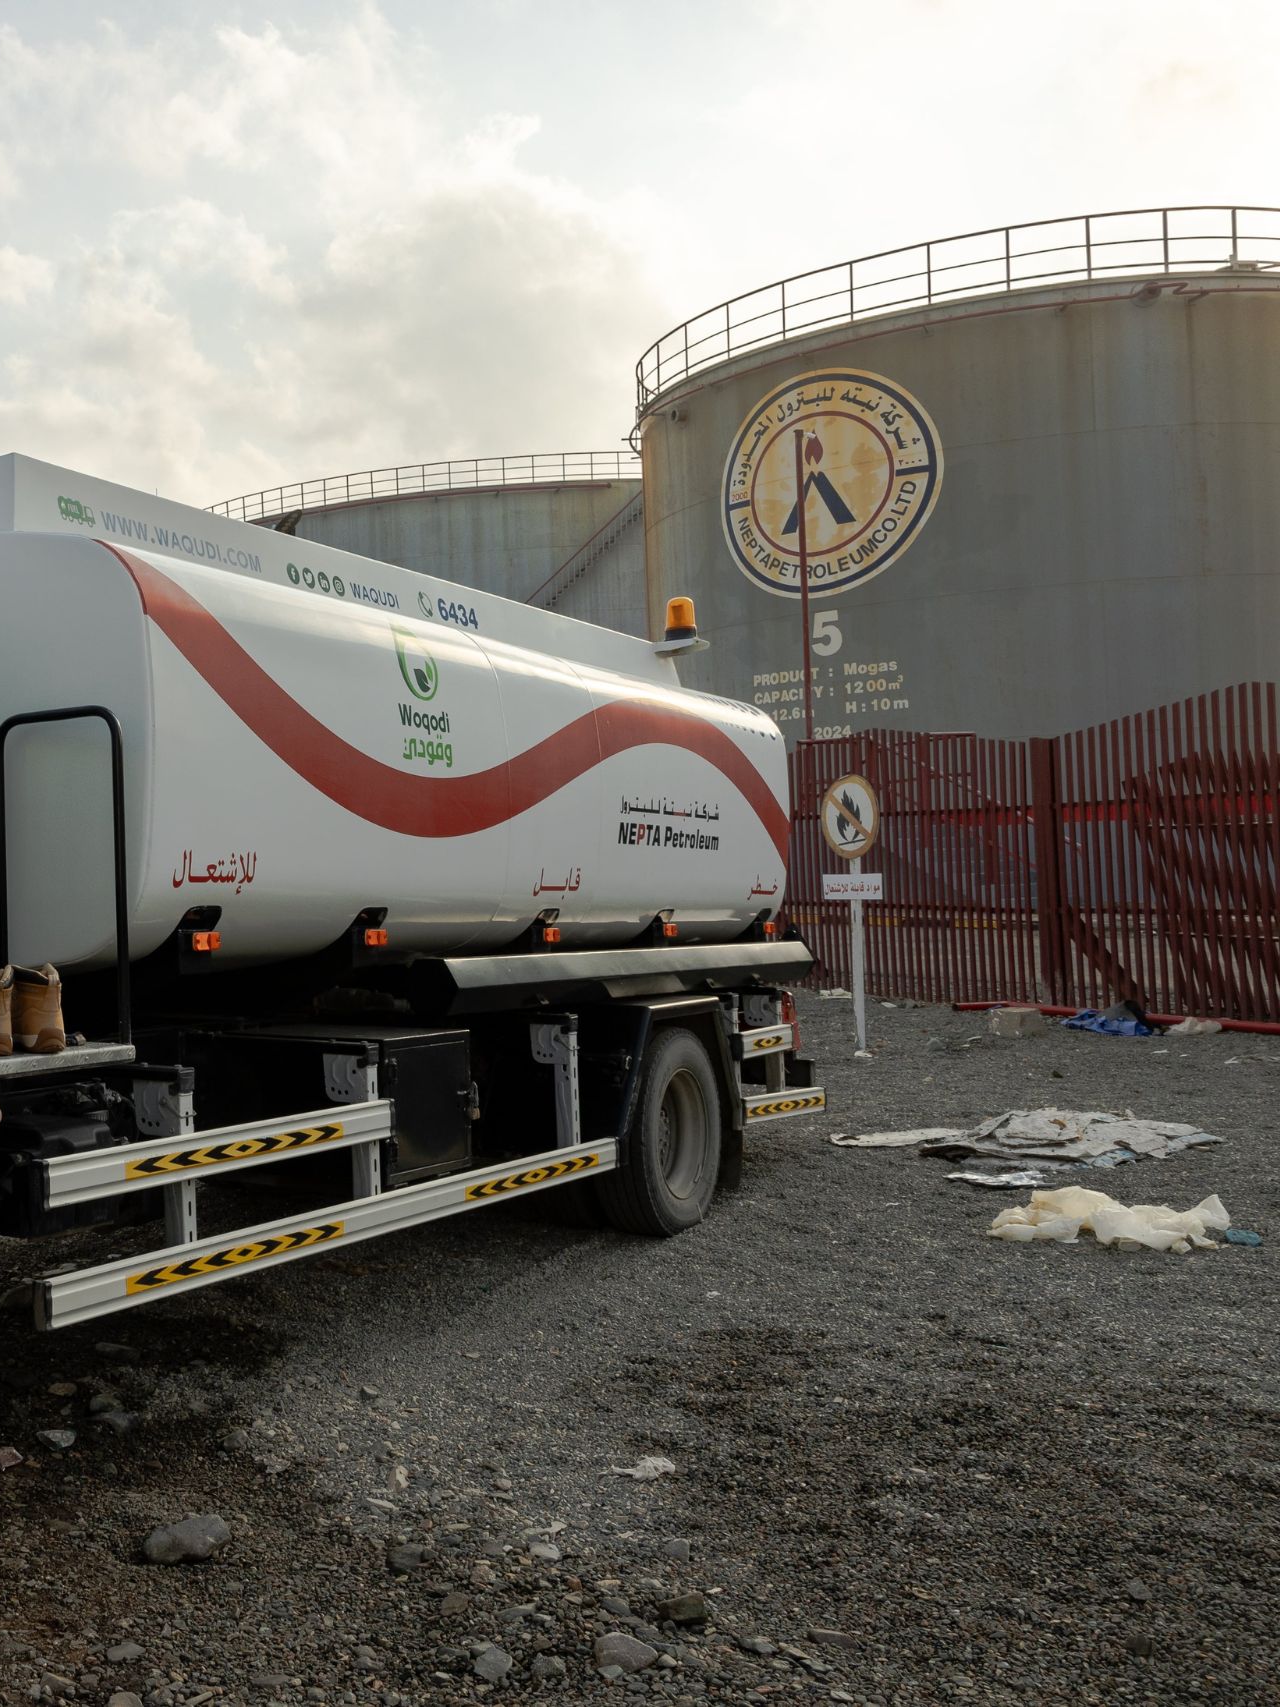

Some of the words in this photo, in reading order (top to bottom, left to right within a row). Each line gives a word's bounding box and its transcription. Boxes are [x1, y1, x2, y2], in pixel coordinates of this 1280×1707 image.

[100, 510, 263, 574] WWW.WAQUDI.COM
[349, 581, 400, 610] WAQUDI
[437, 598, 479, 630] 6434
[812, 609, 843, 657] 5
[843, 661, 899, 676] Mogas
[754, 685, 824, 705] CAPACIY
[814, 725, 852, 739] 2024
[402, 734, 453, 768] وقودي
[618, 822, 661, 847] NEPTA
[664, 826, 720, 851] Petroleum
[172, 848, 258, 895] للإشتعال
[532, 867, 582, 901] قابل
[747, 873, 779, 901] خطر
